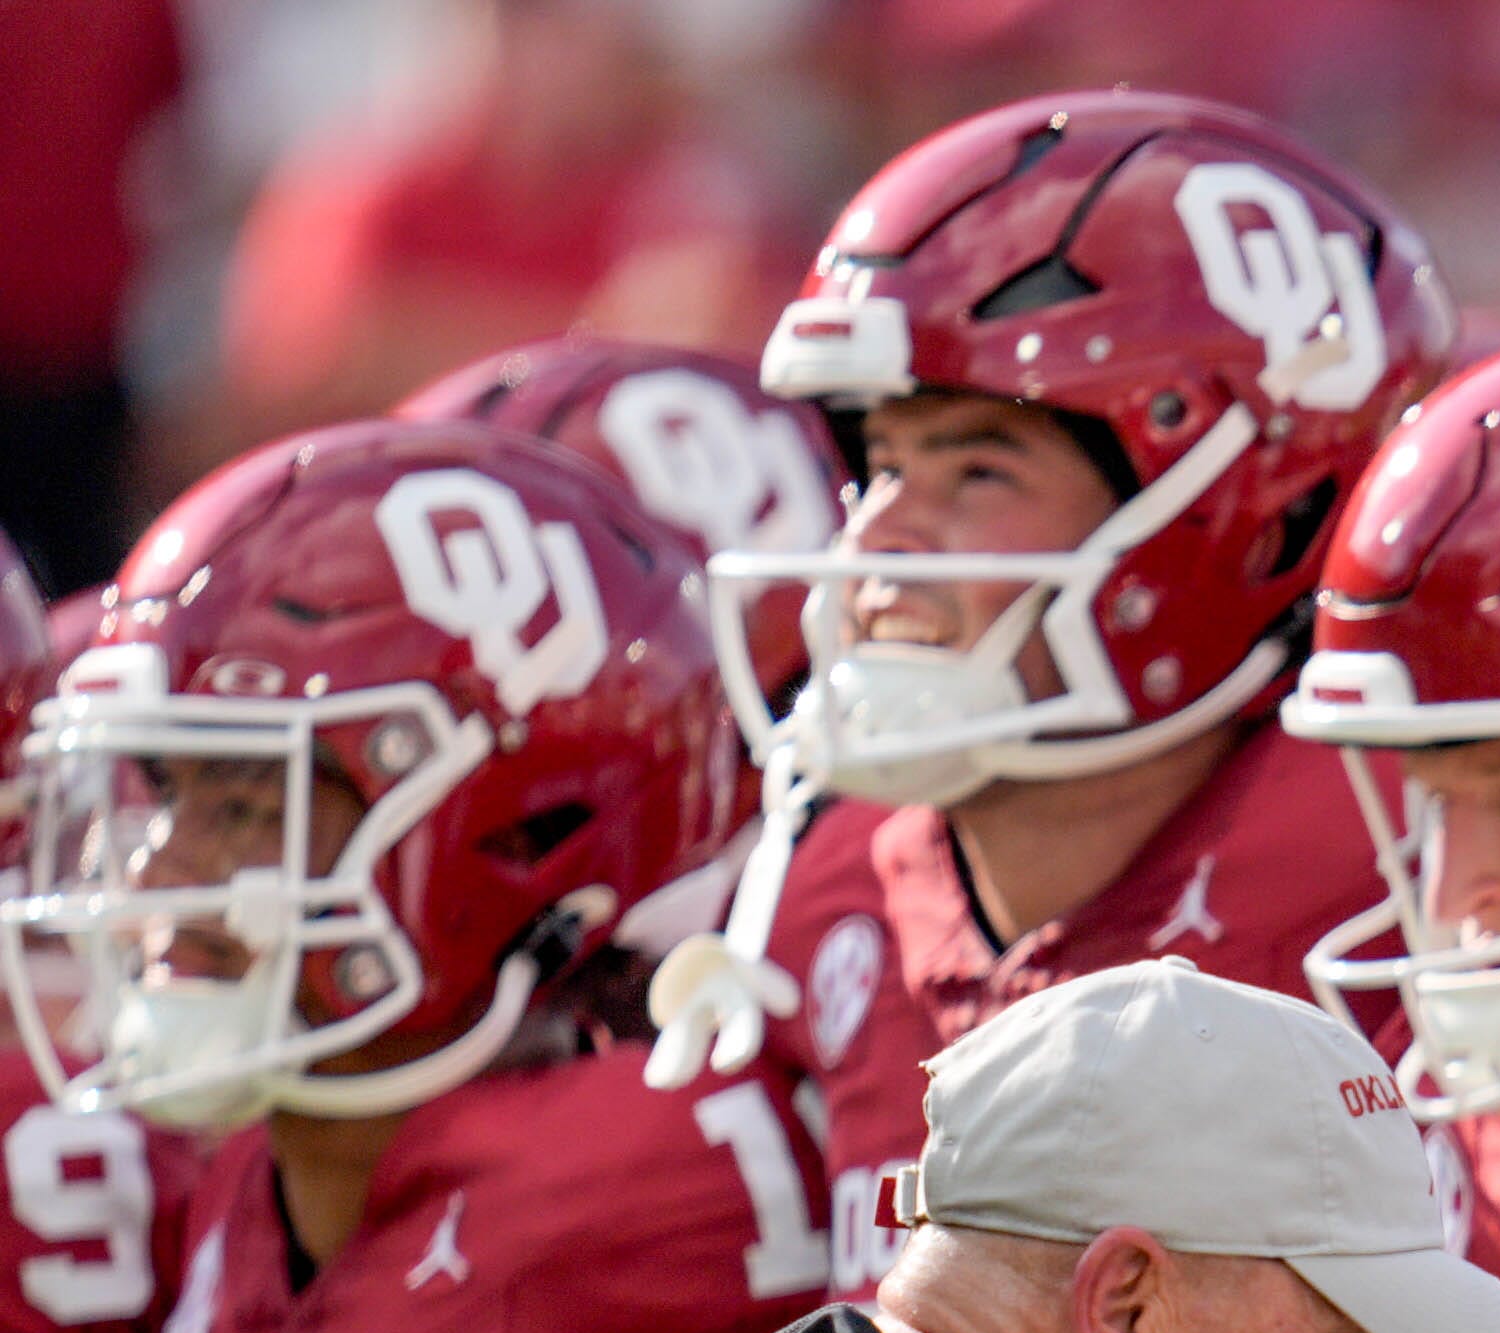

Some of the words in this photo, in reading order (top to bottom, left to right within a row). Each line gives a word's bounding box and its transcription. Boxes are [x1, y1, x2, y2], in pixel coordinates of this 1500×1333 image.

[1175, 162, 1388, 411] OU
[376, 469, 607, 714] OU
[4, 1106, 155, 1325] 9
